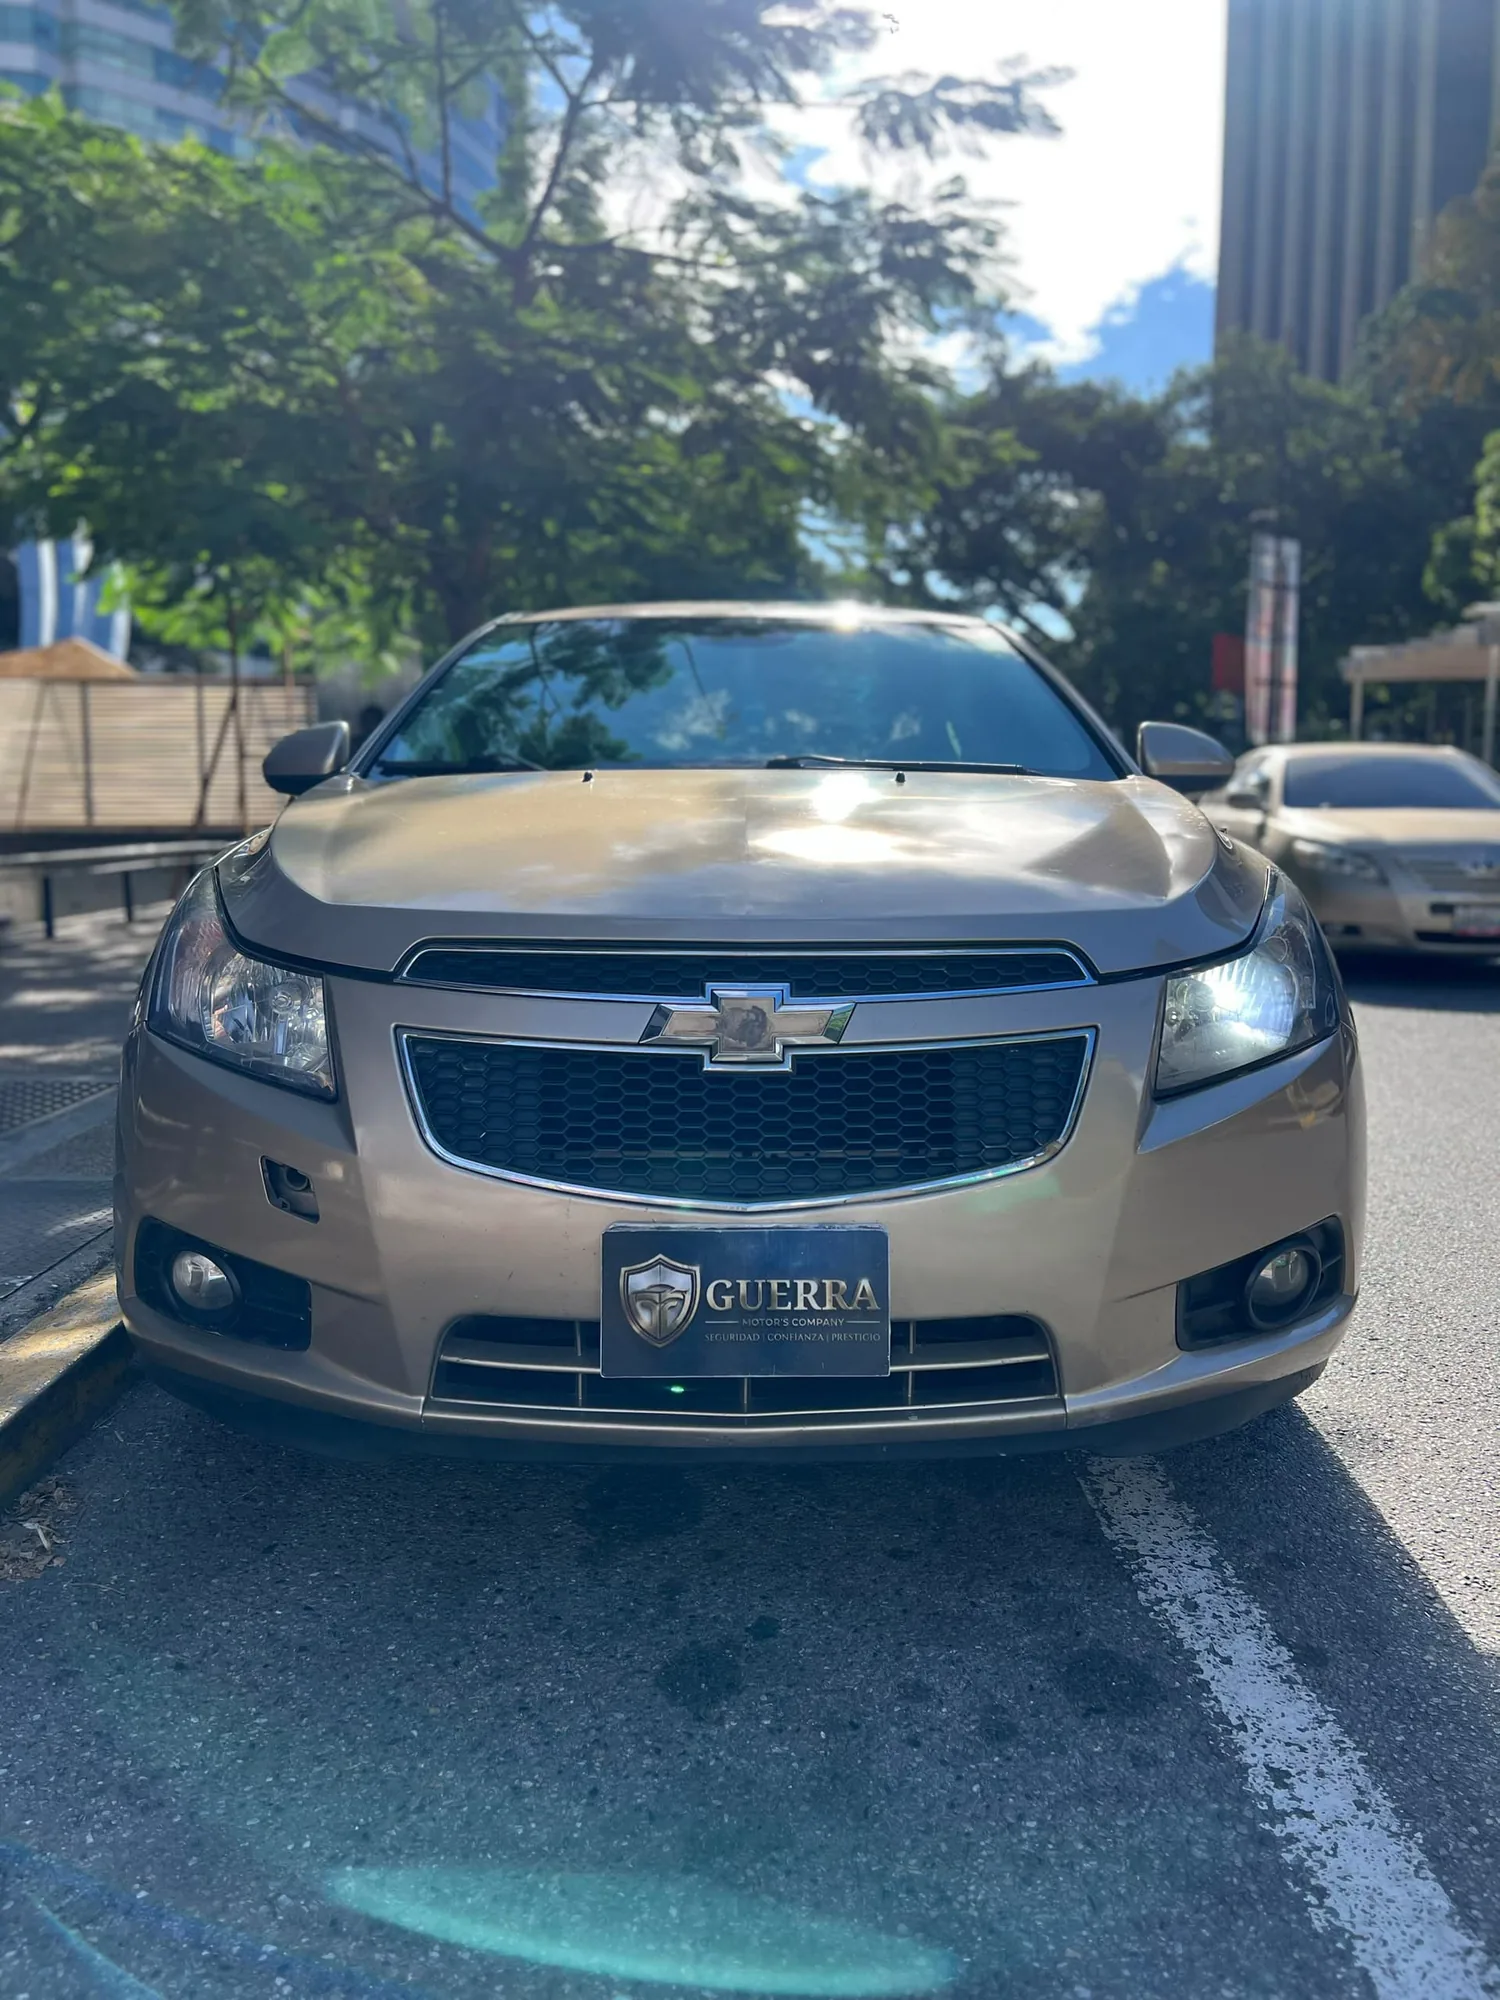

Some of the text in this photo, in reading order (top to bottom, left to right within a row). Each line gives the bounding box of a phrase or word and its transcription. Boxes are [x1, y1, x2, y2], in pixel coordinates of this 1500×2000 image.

[705, 1277, 881, 1311] GUERRA
[742, 1317, 845, 1327] MOTOR'S COMPANY
[705, 1332, 881, 1342] SEGURIDAD CONFIANZA PRESTIGIO
